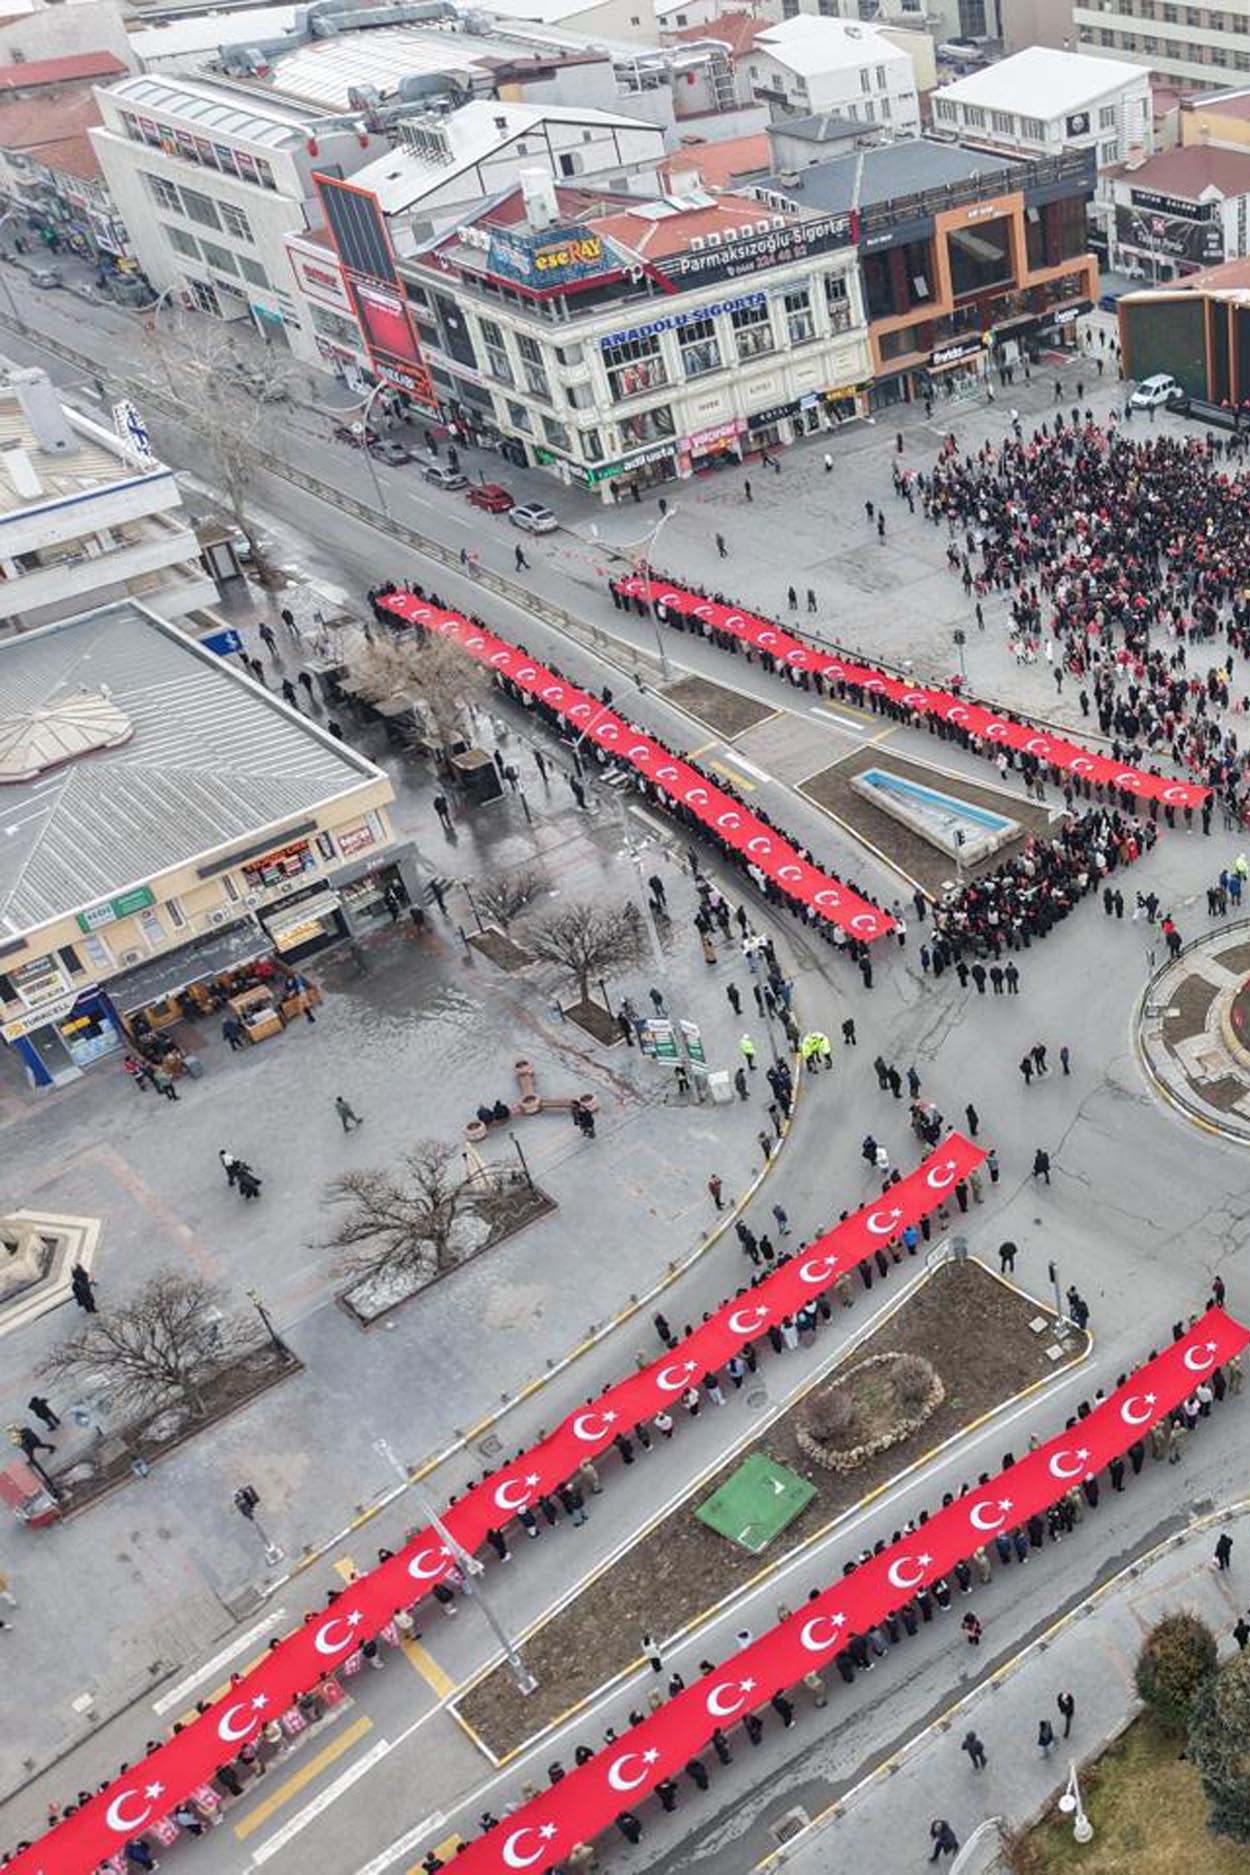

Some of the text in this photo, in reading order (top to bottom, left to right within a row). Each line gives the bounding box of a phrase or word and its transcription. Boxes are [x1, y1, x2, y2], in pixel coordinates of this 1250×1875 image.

[680, 218, 844, 274] Parmaksızoğlu Sigorta
[600, 314, 688, 348] ANADOLU
